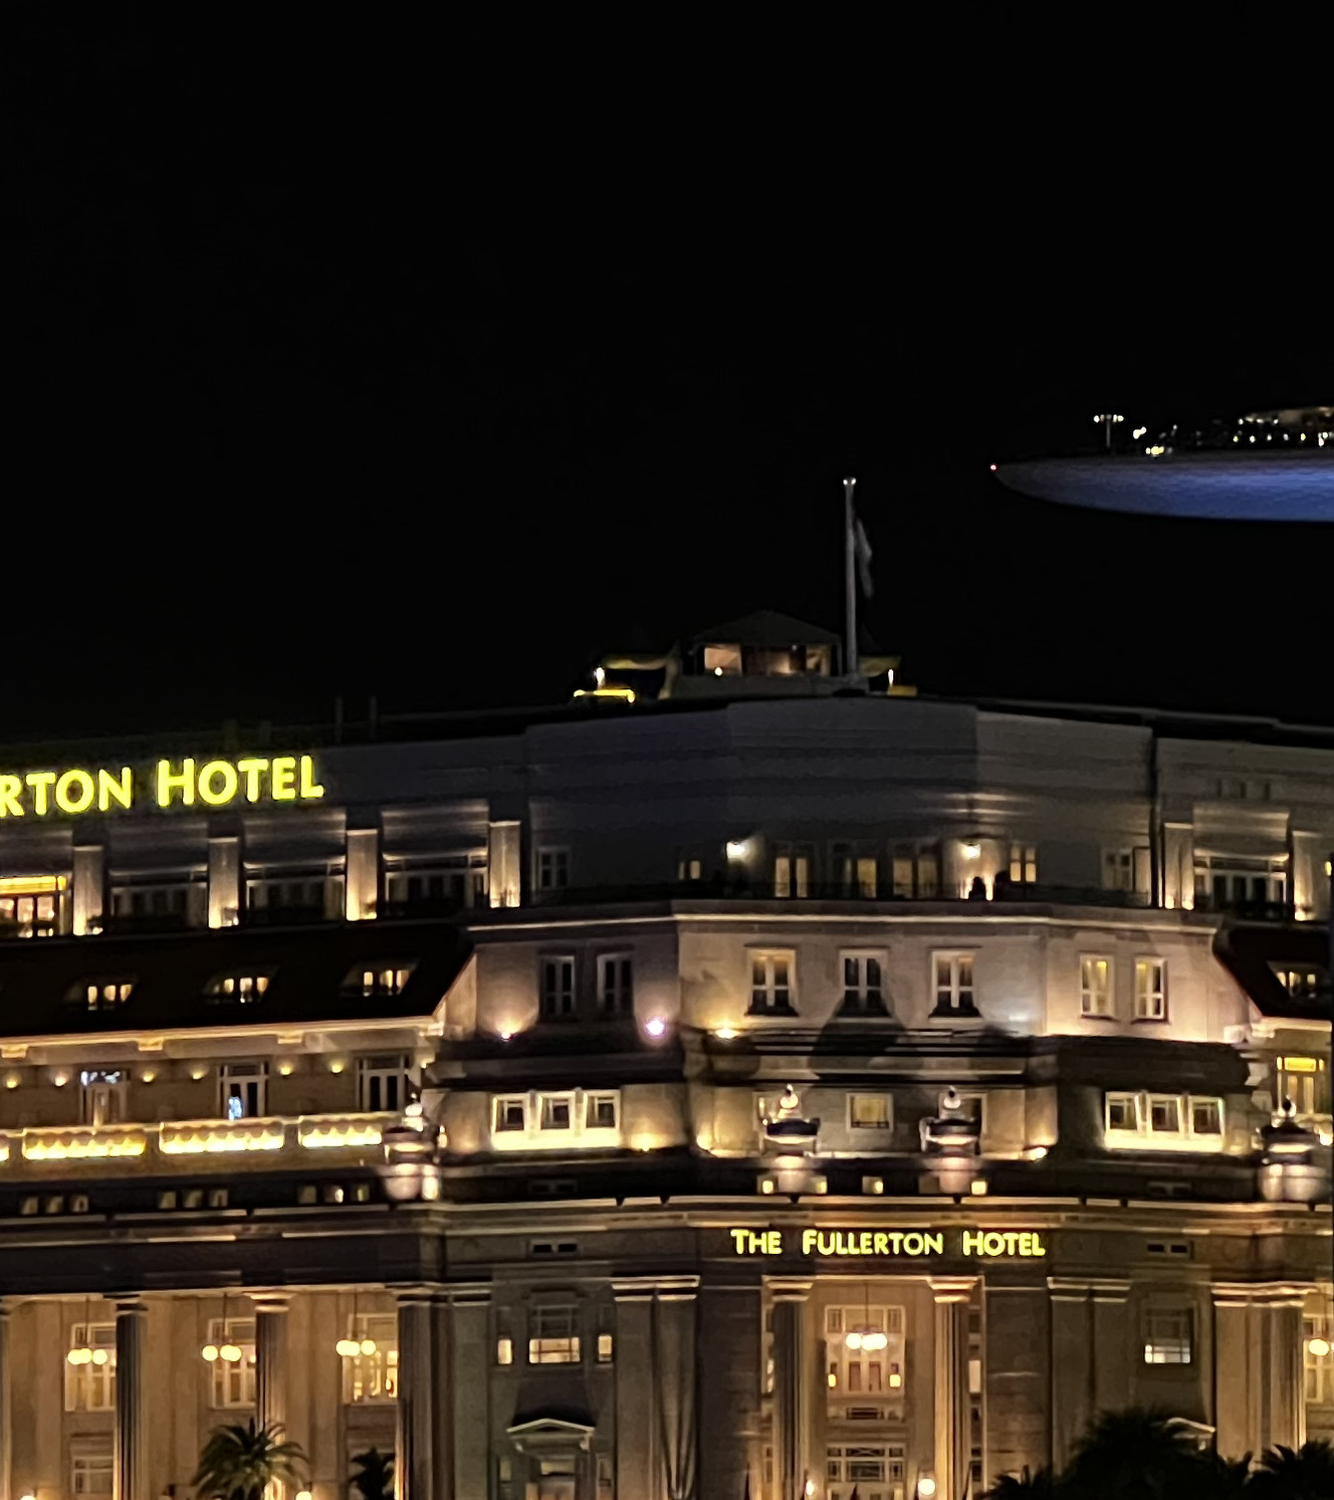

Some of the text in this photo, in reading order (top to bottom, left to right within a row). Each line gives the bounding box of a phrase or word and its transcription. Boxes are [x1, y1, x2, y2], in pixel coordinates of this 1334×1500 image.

[157, 755, 324, 808] HOTEL
[731, 1229, 1046, 1257] THE FULLERTON HOTEL
